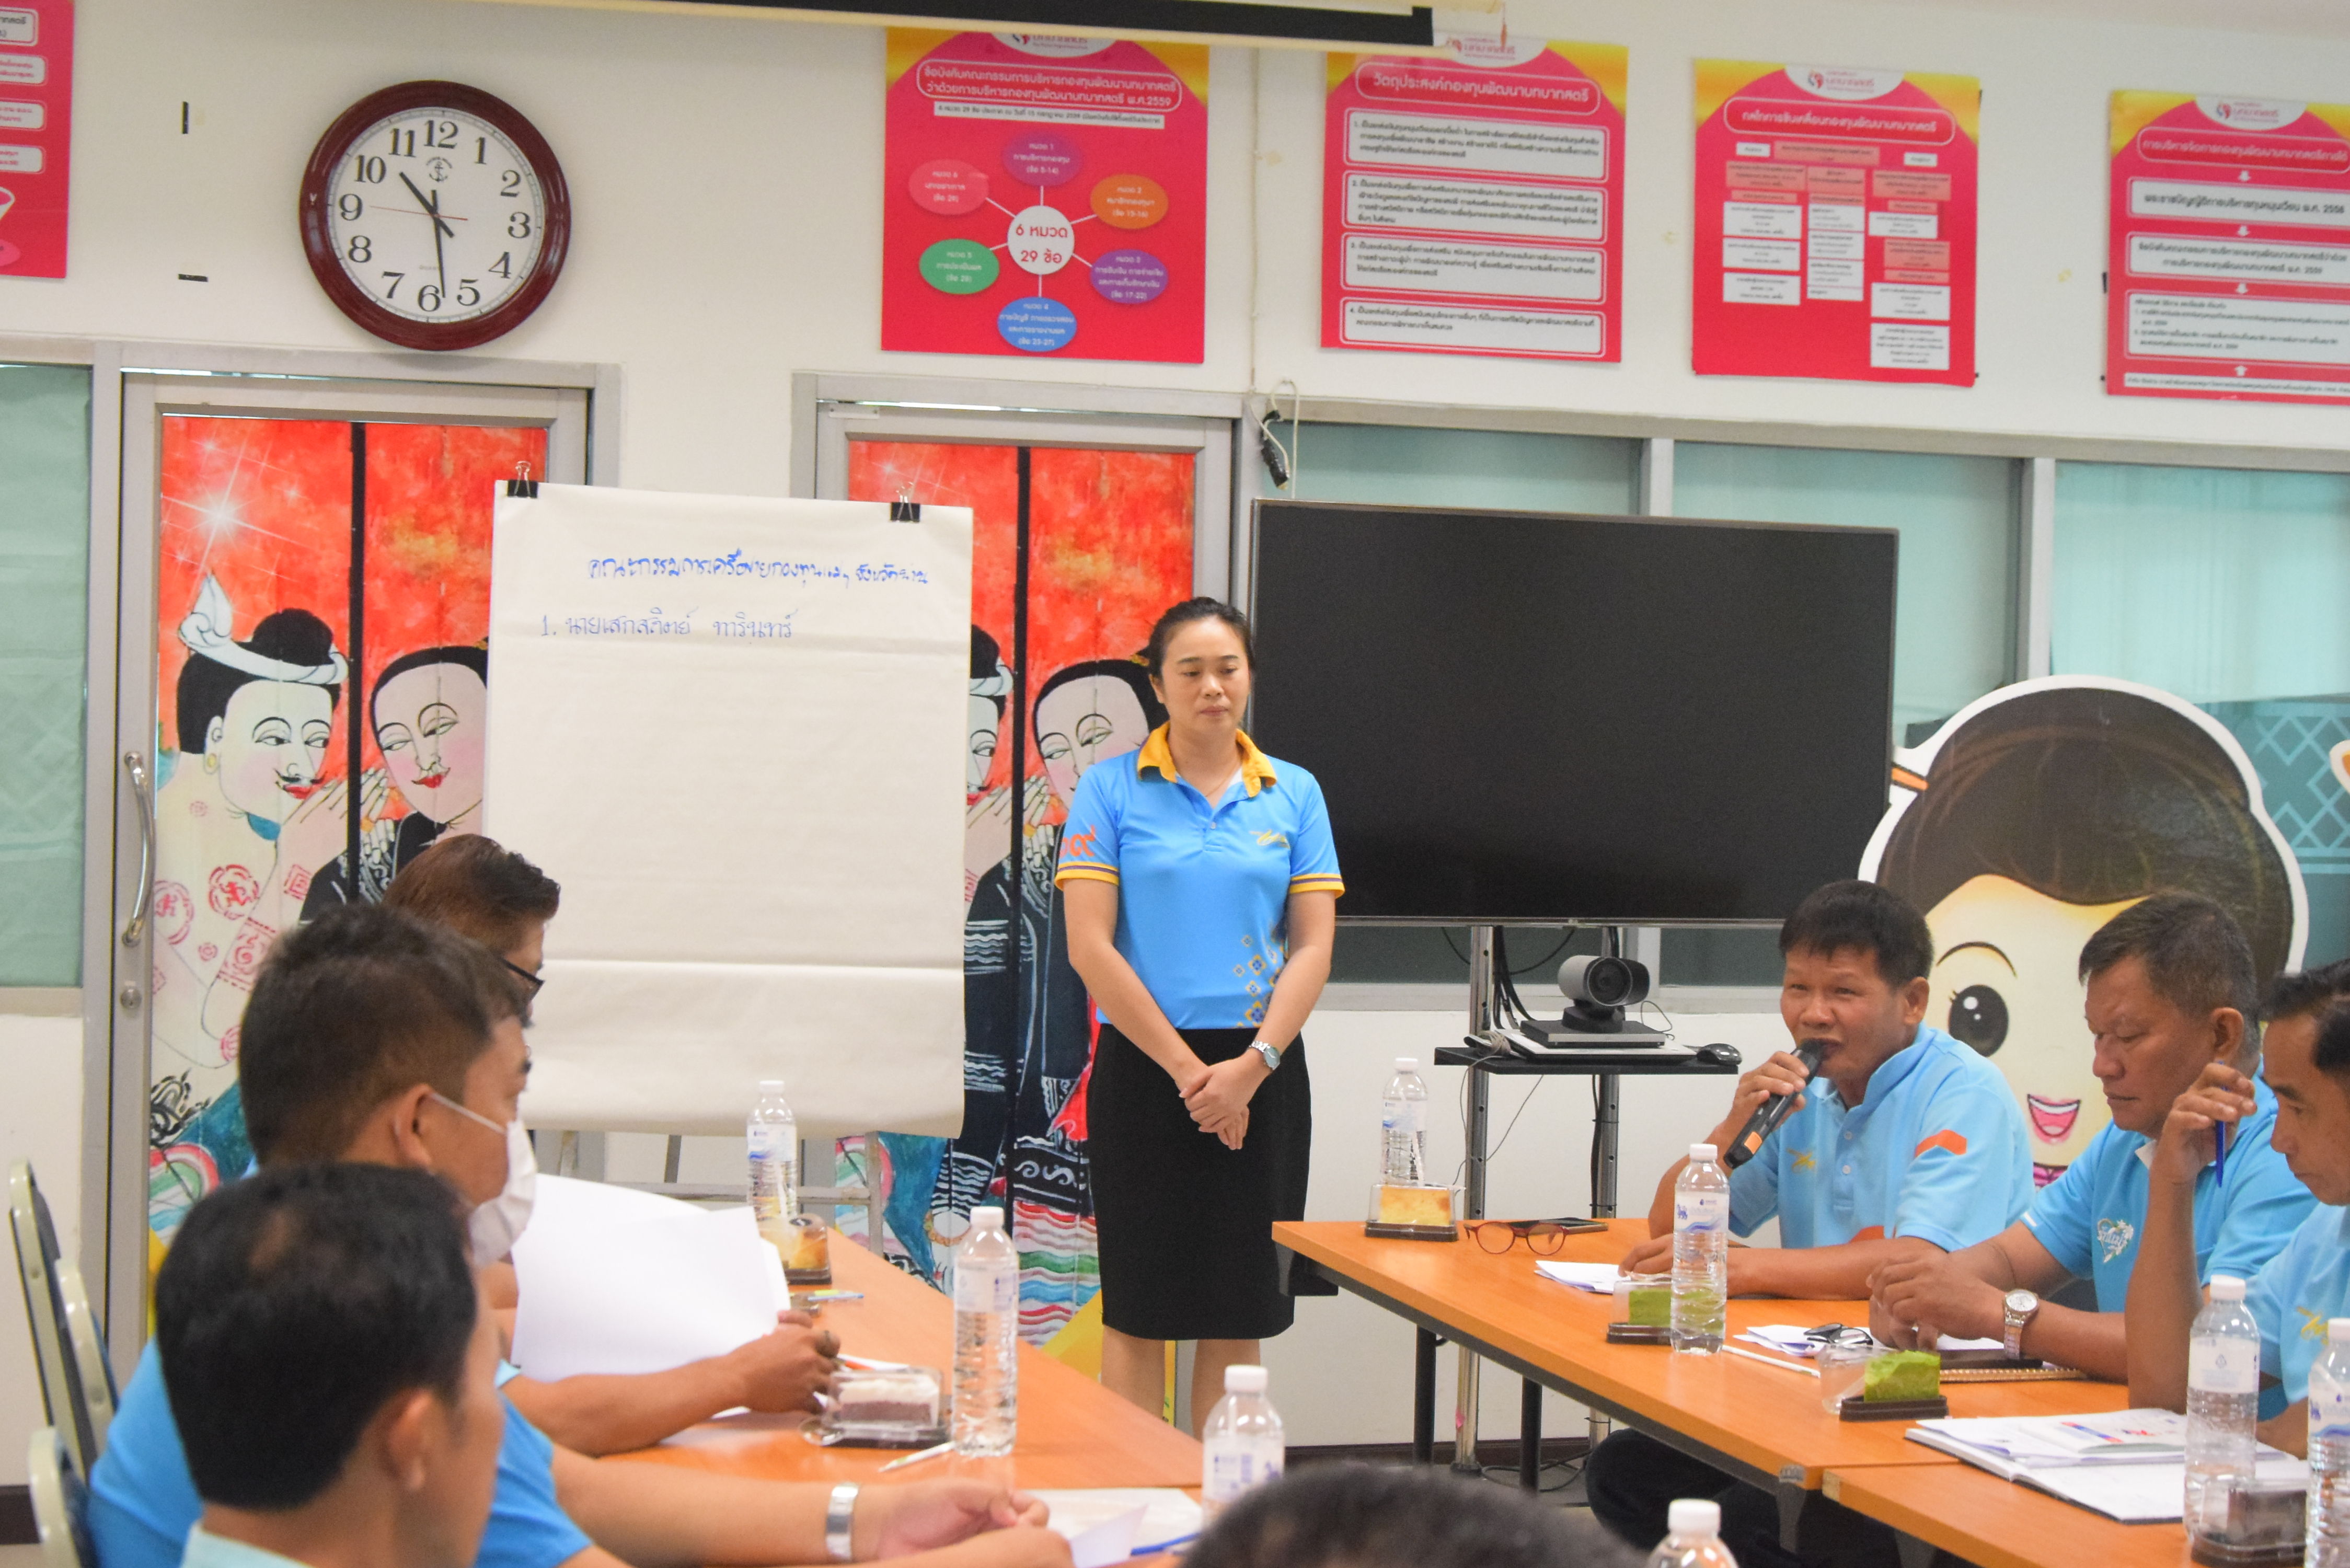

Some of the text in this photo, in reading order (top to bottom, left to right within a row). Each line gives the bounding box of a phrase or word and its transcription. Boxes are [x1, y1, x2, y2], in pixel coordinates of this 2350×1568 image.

[1374, 72, 1589, 102] วัตถุประสงค์กองทุนพัฒนาบทบาทสตรี
[389, 128, 416, 158] 11
[423, 120, 458, 149] 12
[475, 136, 487, 165] 1
[354, 155, 387, 183] 10
[500, 169, 521, 198] 2
[339, 193, 363, 221] 9
[507, 212, 531, 239] 3
[1016, 224, 1068, 238] 6 หมวด
[348, 235, 372, 263] 8
[1021, 248, 1063, 263] 29 ข้อ
[488, 251, 512, 279] 4
[381, 271, 405, 299] 7
[417, 285, 442, 312] 6
[456, 279, 480, 306] 5
[542, 615, 557, 637] 1.
